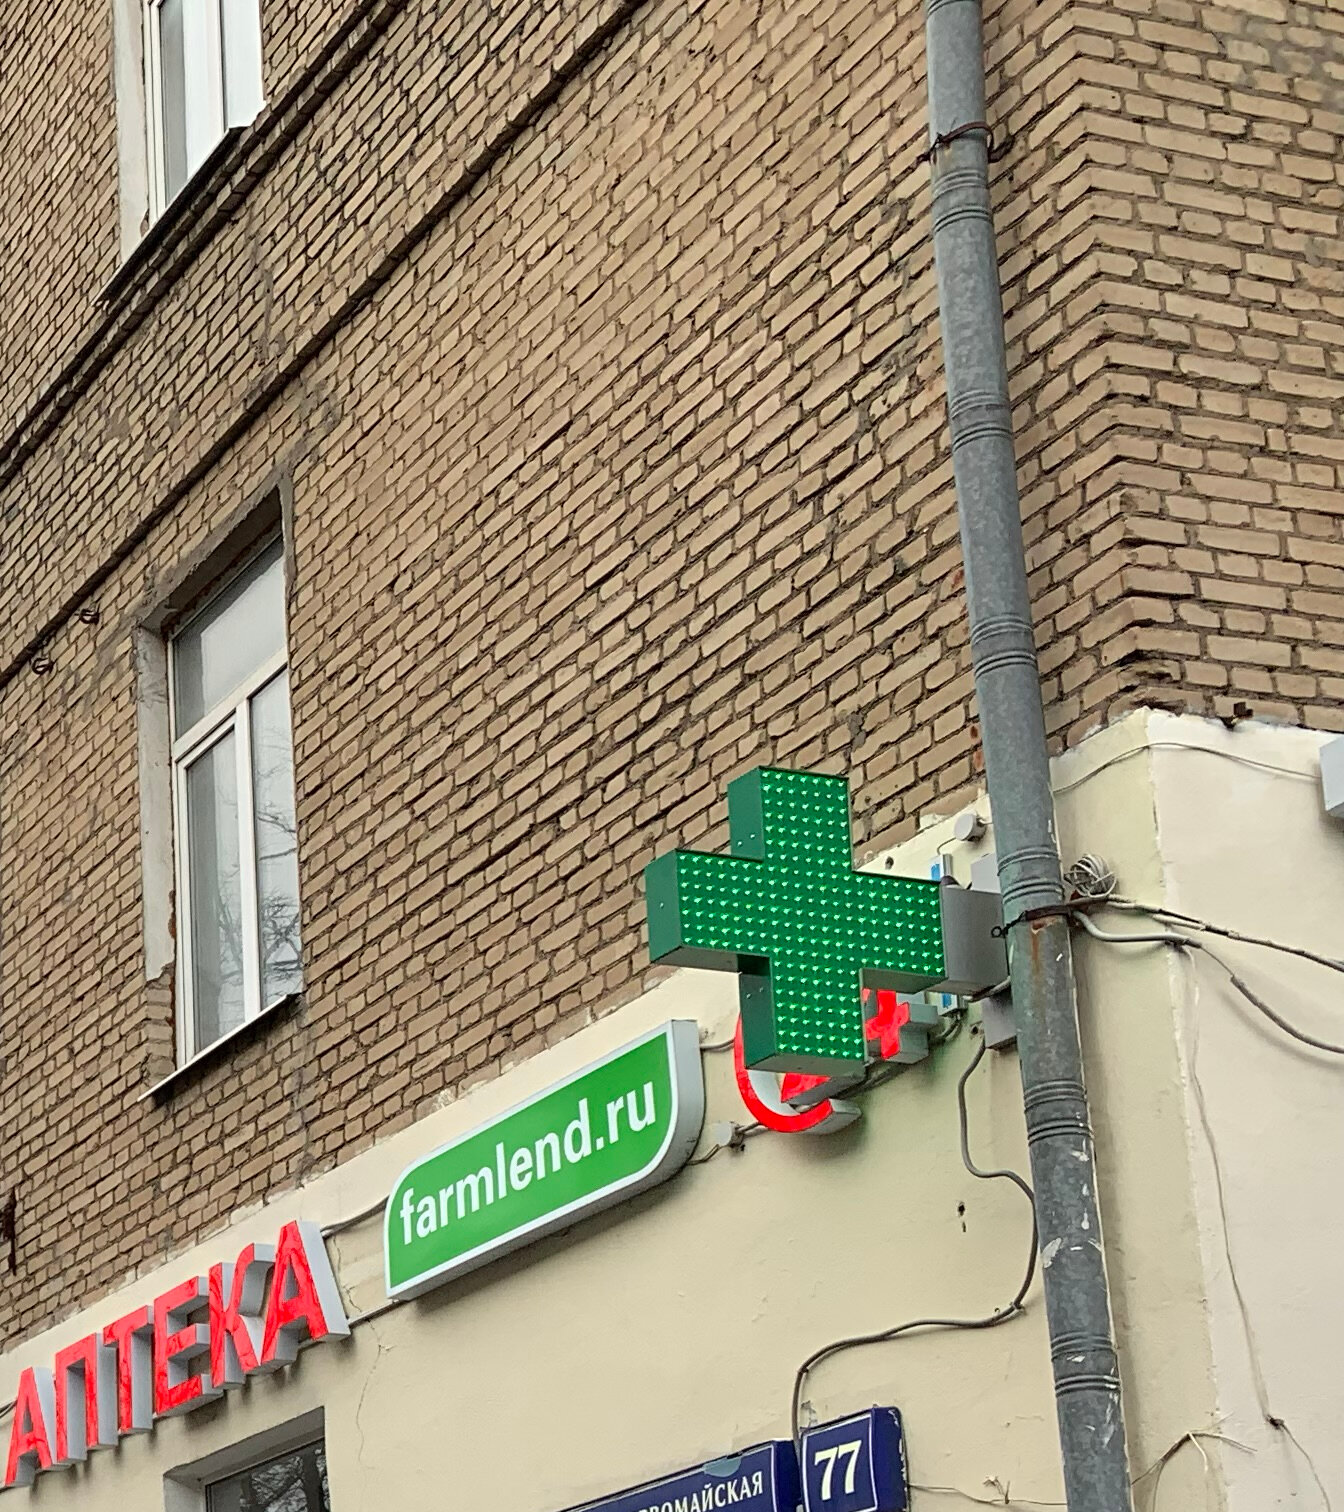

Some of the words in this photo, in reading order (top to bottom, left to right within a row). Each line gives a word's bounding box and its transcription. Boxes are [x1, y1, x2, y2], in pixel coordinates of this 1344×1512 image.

[399, 1081, 657, 1245] farmlend.ru
[4, 1219, 332, 1487] АПТЕКА
[813, 1439, 863, 1501] 77
